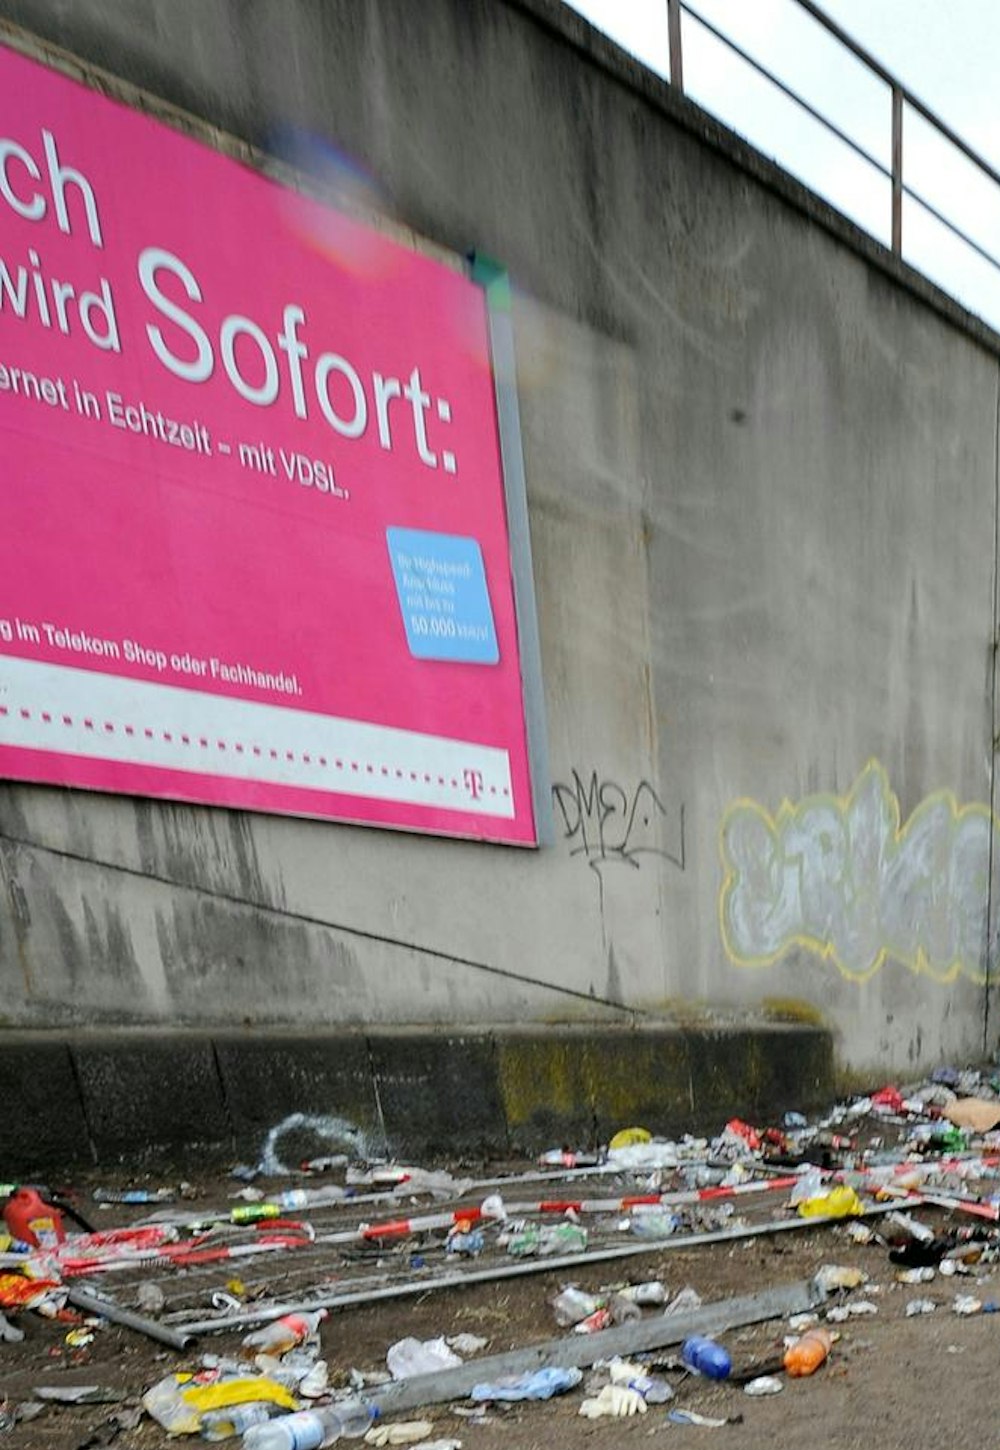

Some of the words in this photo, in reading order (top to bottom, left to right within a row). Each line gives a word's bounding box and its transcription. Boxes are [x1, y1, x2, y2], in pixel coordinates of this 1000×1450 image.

[137, 247, 457, 474] Sofort:
[74, 378, 102, 421] in
[106, 391, 212, 456] Echtzeit
[239, 440, 277, 476] mit
[42, 622, 120, 660] Telekom
[123, 639, 167, 670] Shop
[171, 656, 207, 677] oder
[210, 658, 303, 695] Fachhandel.
[463, 769, 483, 799] T
